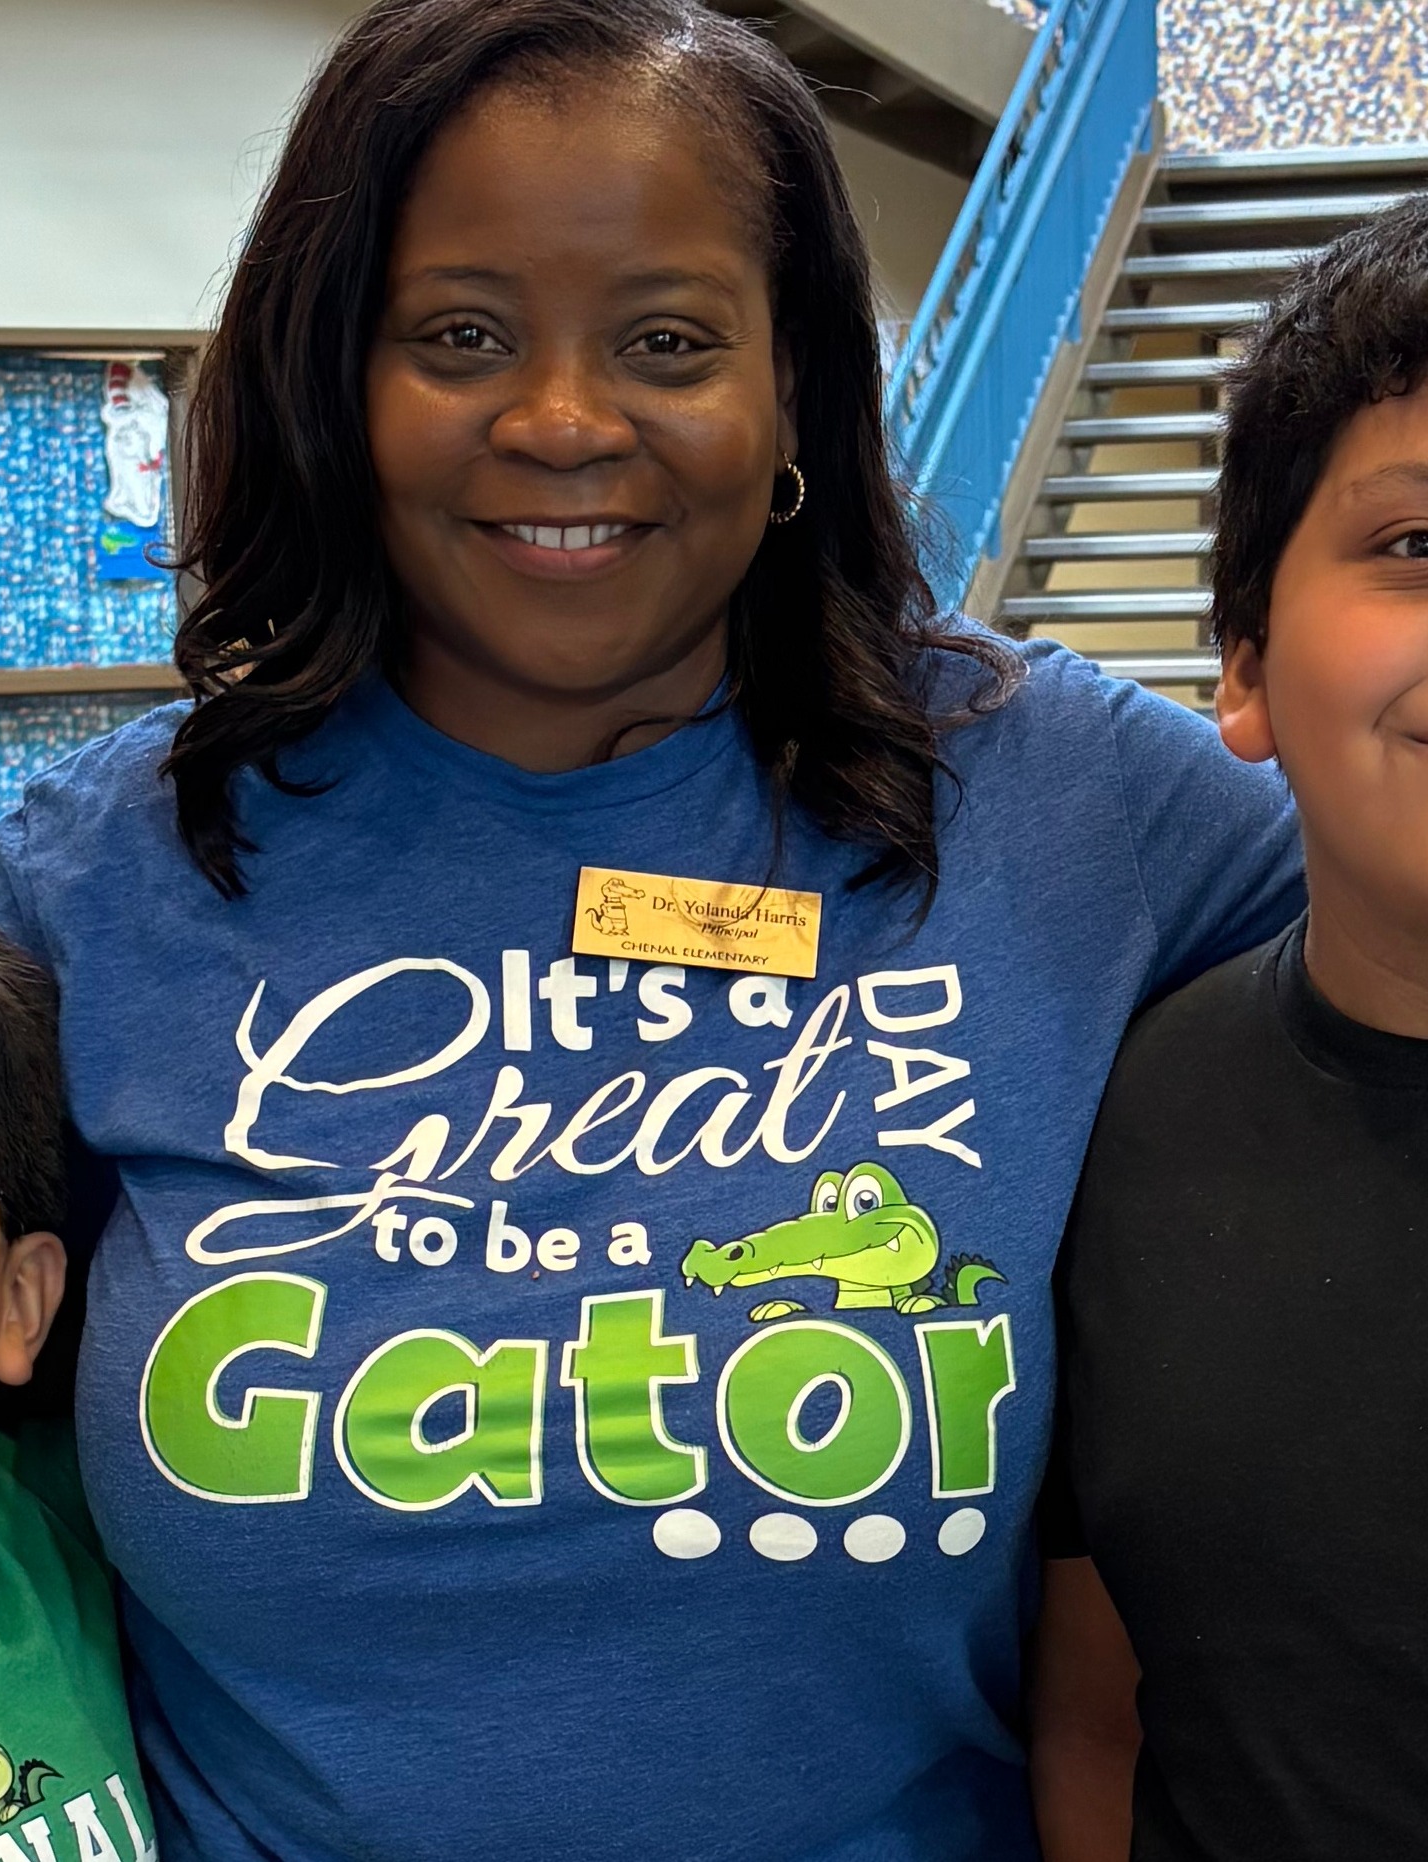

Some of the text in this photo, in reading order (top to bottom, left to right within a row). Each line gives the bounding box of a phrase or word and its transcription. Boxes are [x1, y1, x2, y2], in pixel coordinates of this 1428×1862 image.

[621, 940, 769, 966] CHENAL ELEMENTARY
[652, 896, 807, 927] Dr. Yolanda Harris
[701, 922, 758, 939] Principal
[502, 949, 794, 1052] It's a
[857, 964, 982, 1168] DAY
[185, 957, 853, 1265] Great
[371, 1201, 652, 1273] to be a
[139, 1270, 1016, 1512] Gator
